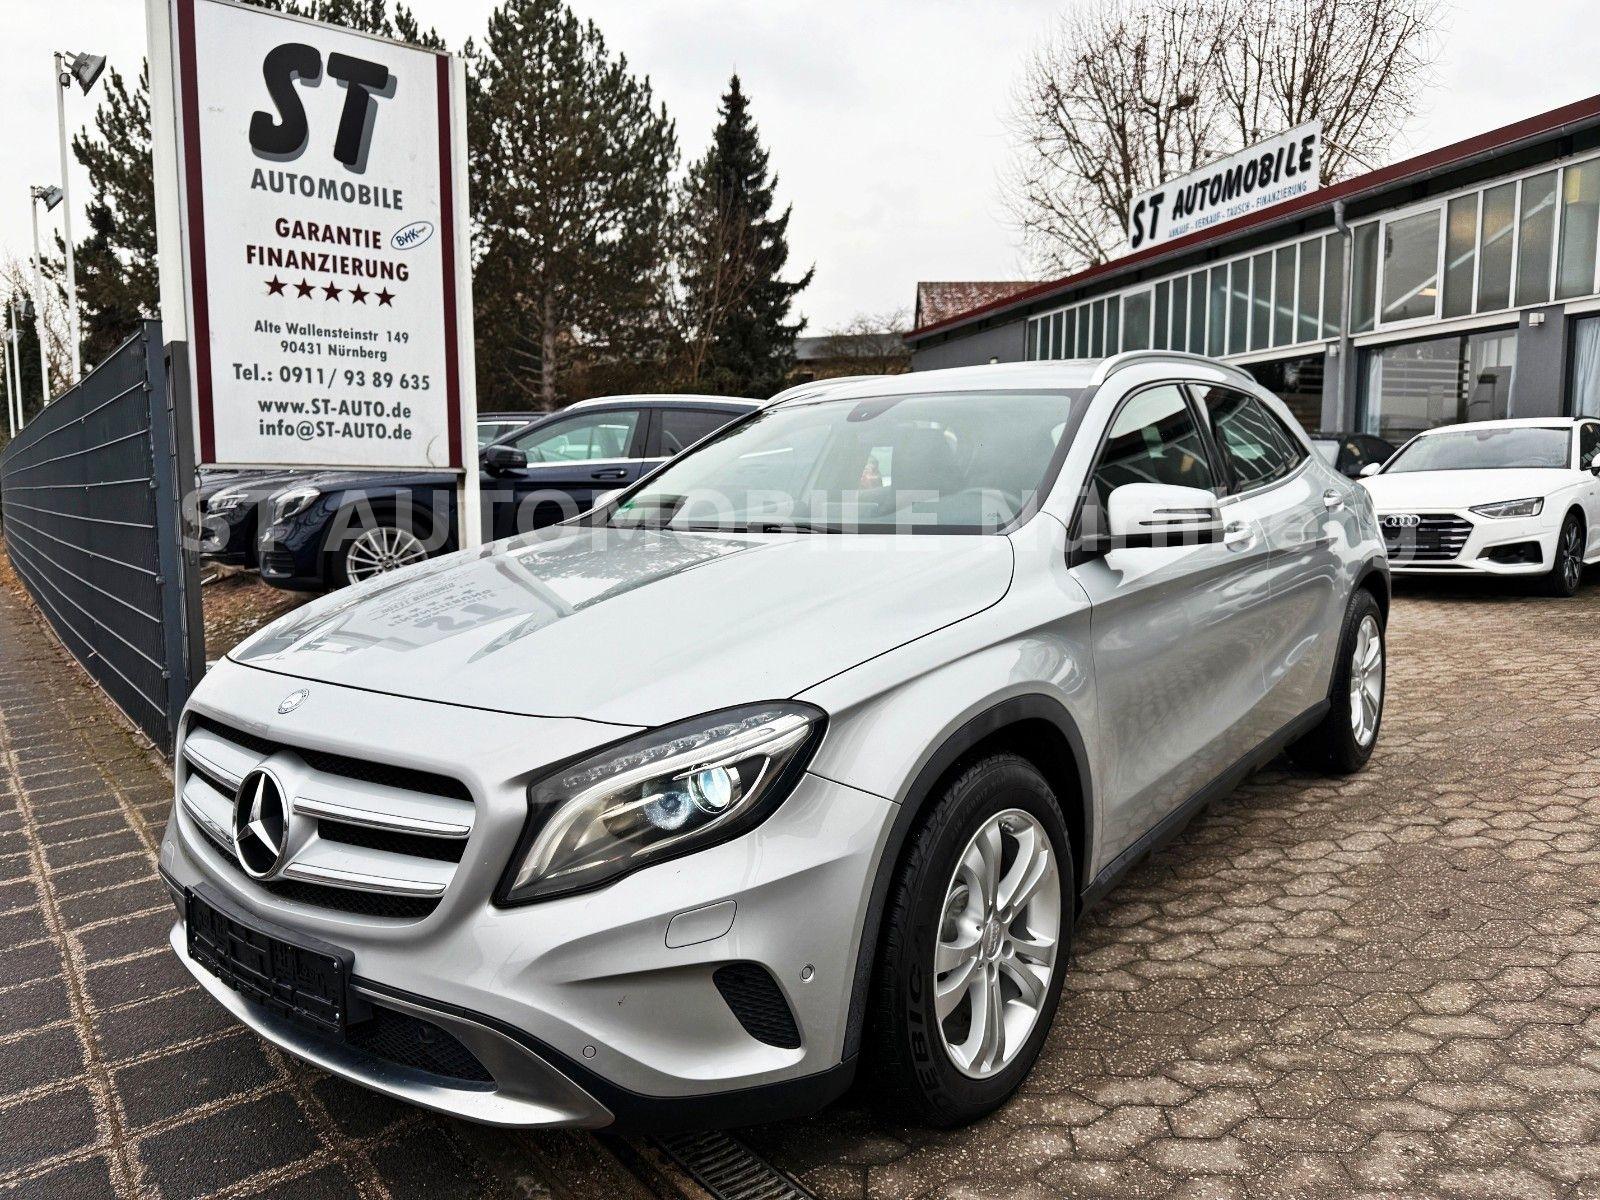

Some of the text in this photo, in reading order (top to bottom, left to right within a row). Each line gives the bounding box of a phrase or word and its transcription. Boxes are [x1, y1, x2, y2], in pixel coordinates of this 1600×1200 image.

[249, 42, 398, 175] ST
[250, 168, 403, 211] AUTOMOBILE
[1131, 134, 1315, 249] ST AUTOMOBILE
[1256, 180, 1308, 211] FINANZIERUNG
[275, 217, 382, 249] GARANTIE
[246, 244, 409, 281] FINANZIERUNG
[254, 320, 410, 344] Alte Wallensteinstr 149
[280, 340, 388, 362] 90431 Nürnberg
[232, 363, 273, 382] Tel.:
[343, 370, 366, 387] 93
[372, 372, 393, 388] 89
[399, 373, 430, 391] 635
[258, 398, 412, 419] www.ST-AUTO.de
[259, 418, 412, 441] info@ST-AUTO.de
